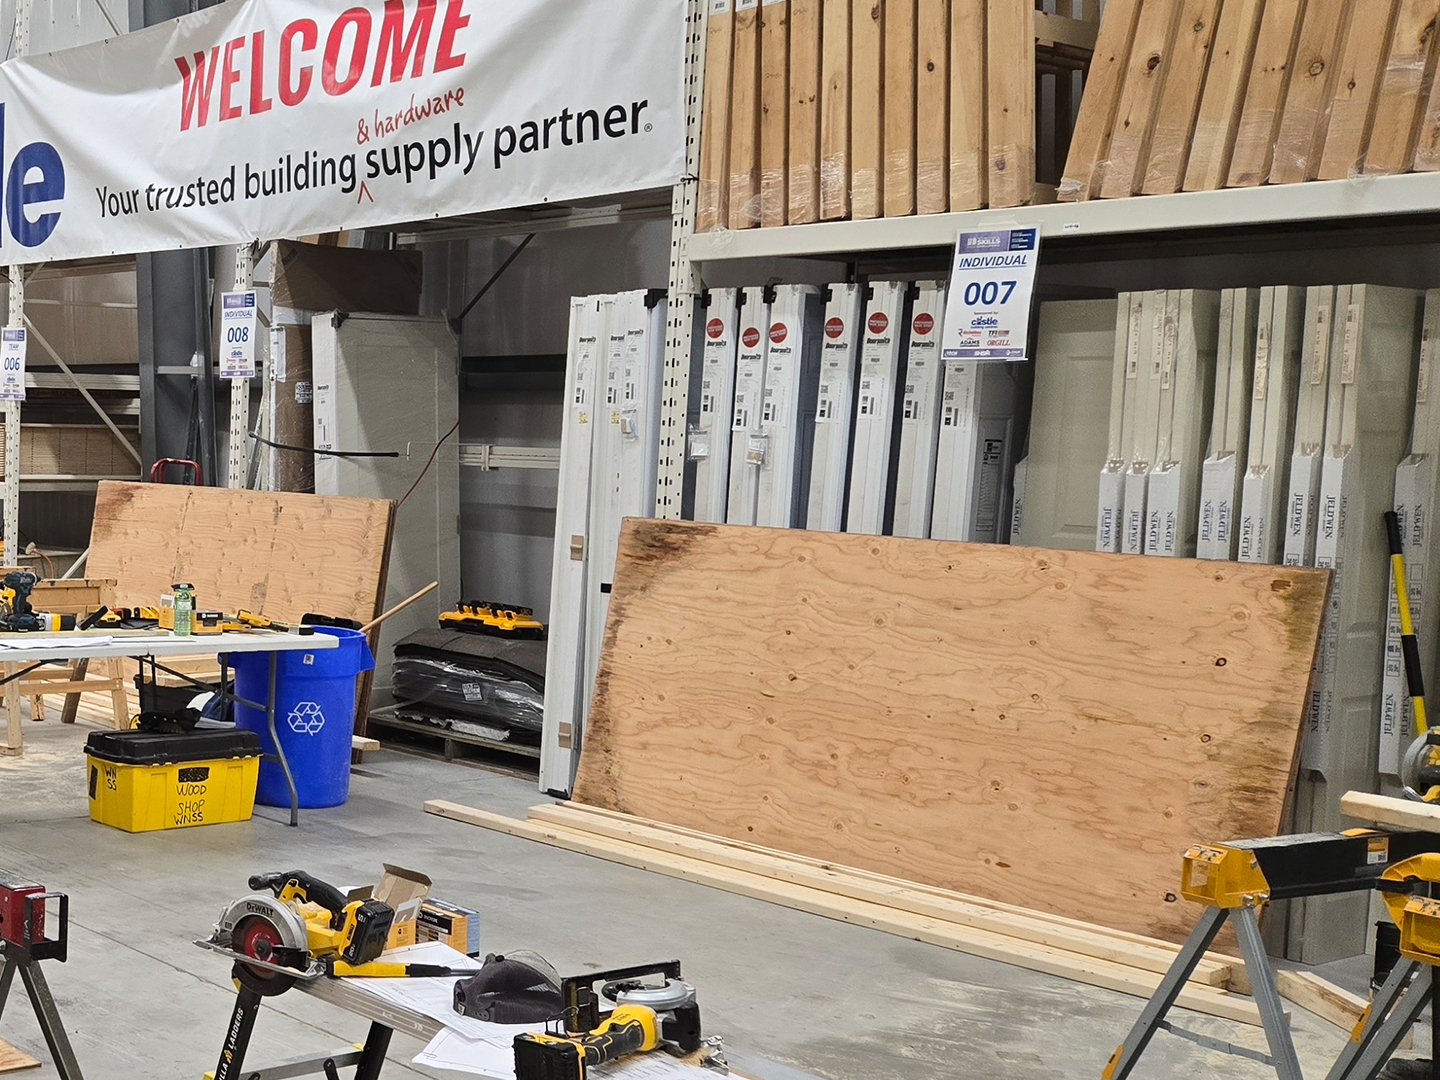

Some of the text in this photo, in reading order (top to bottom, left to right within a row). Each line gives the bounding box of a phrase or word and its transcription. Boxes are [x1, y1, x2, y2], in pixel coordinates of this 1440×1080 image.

[174, 0, 471, 132] WELCOME
[356, 86, 465, 145] & hardware
[95, 185, 139, 218] Your
[145, 165, 235, 212] trusted
[244, 150, 356, 194] building
[365, 122, 484, 184] supply
[959, 254, 1028, 269] INDIVIDUAL
[964, 280, 1017, 306] 007
[227, 326, 250, 343] 008
[4, 357, 21, 371] 006
[105, 766, 117, 779] WN
[176, 784, 207, 797] WOOD
[177, 799, 205, 816] SHOP
[174, 811, 204, 826] WNSS
[228, 1007, 244, 1050] LADDERS
